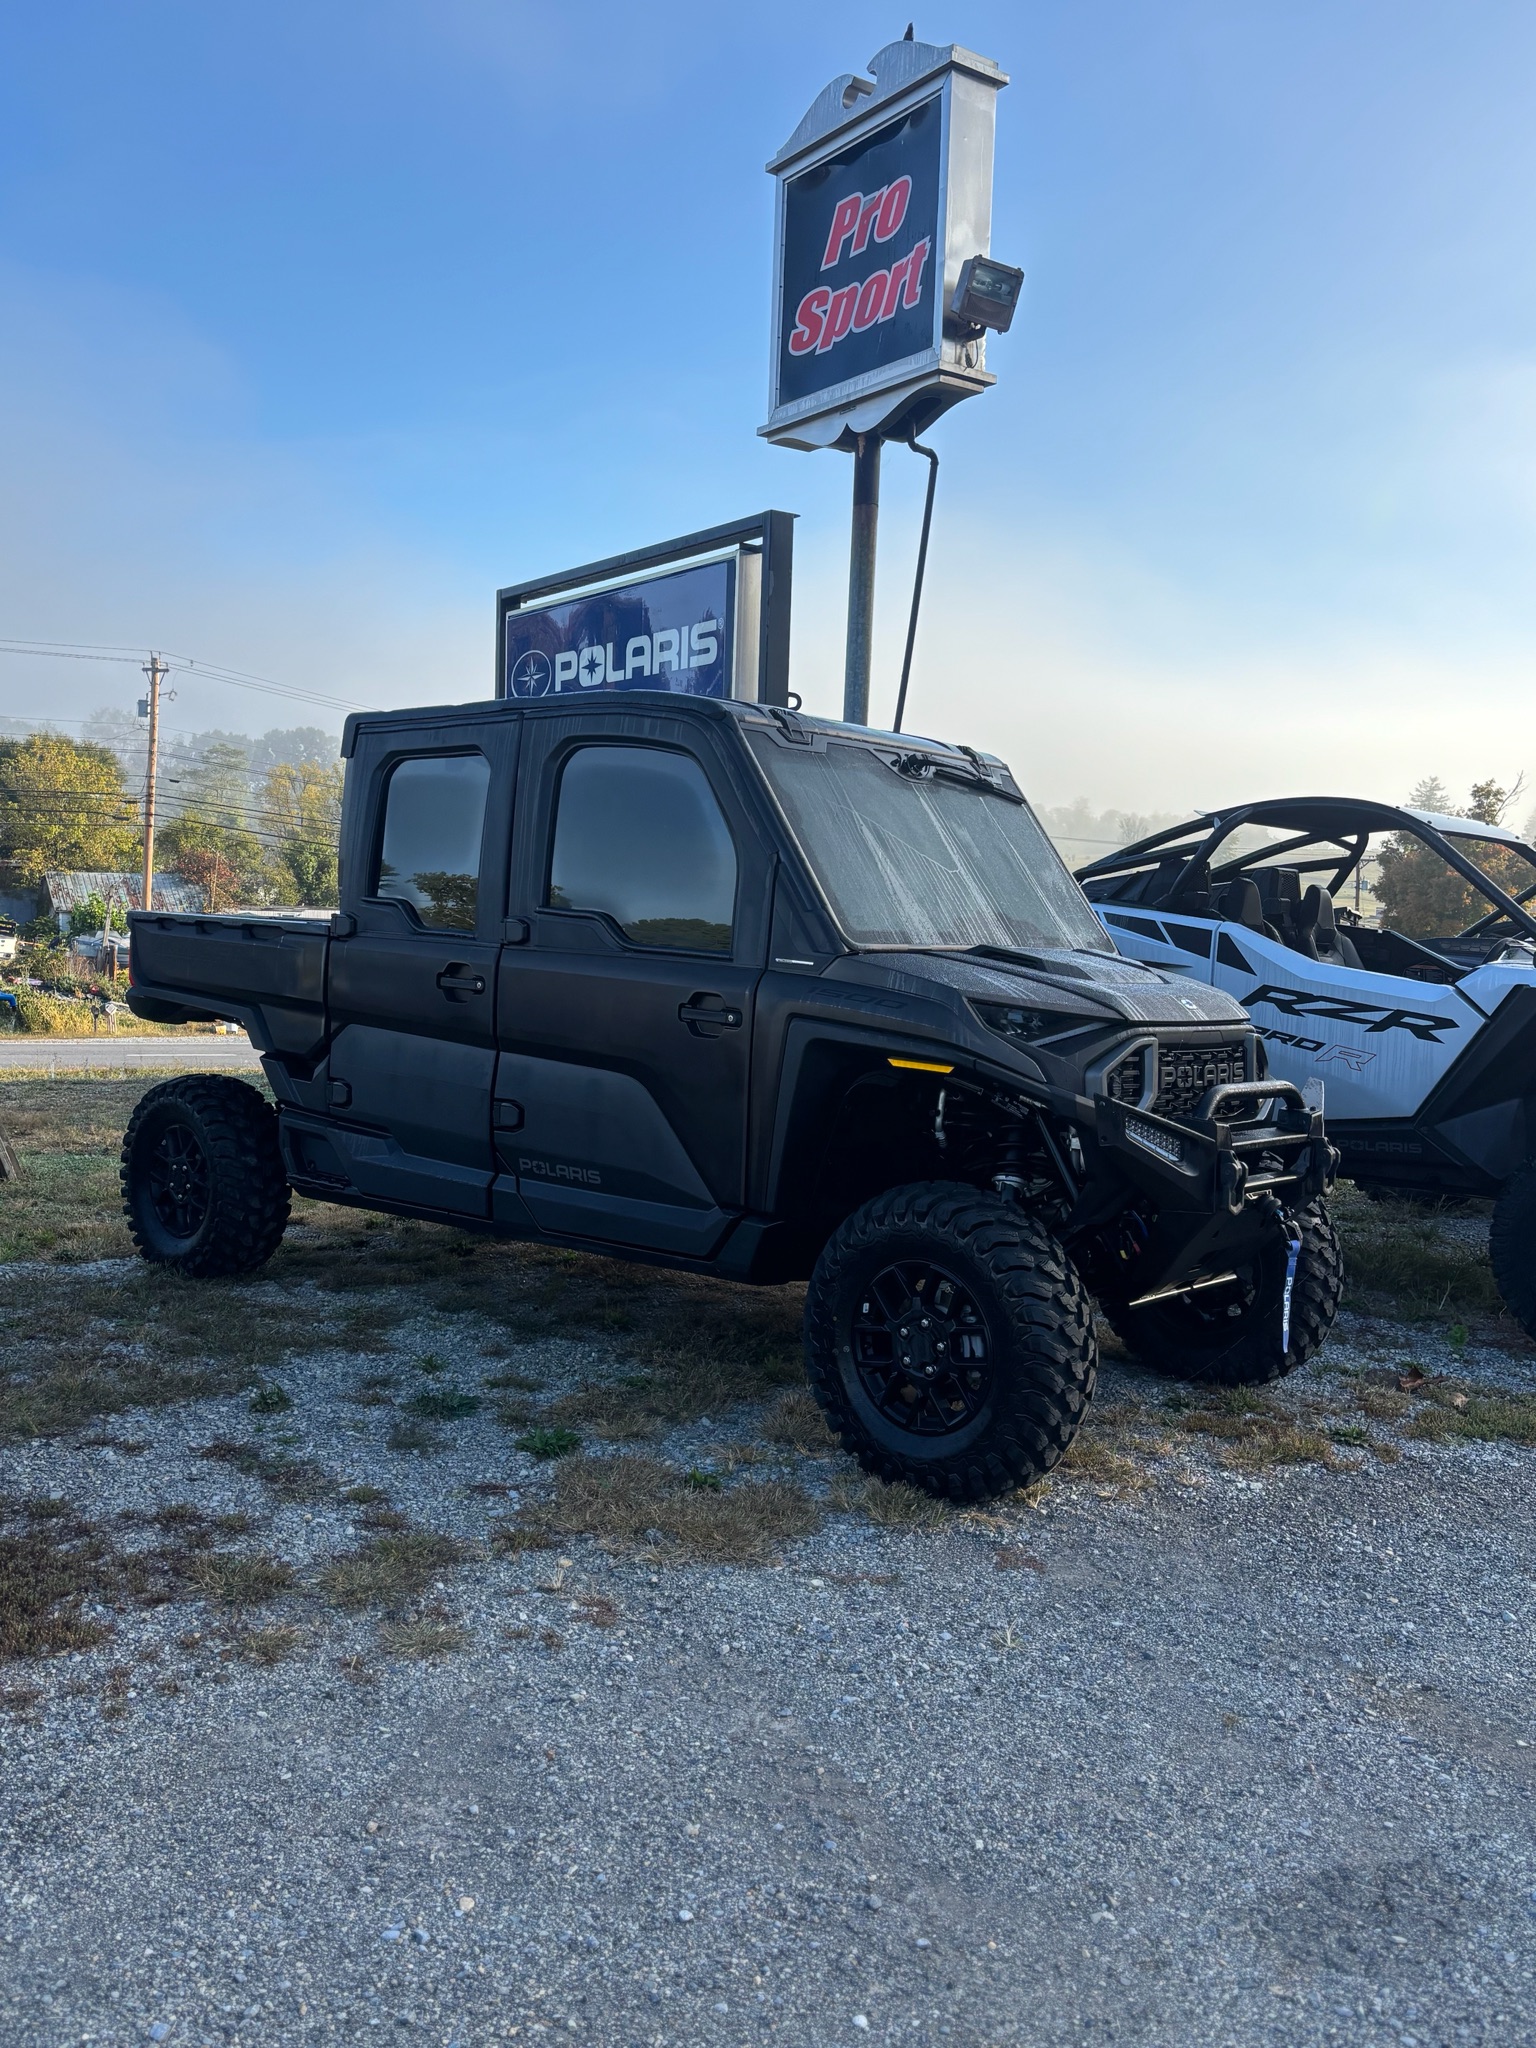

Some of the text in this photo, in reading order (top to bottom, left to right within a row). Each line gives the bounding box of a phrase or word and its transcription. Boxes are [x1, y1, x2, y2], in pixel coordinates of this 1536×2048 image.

[820, 174, 912, 271] Pro
[788, 235, 931, 356] Sport
[555, 618, 718, 692] POLARIS
[806, 986, 908, 1009] 1500
[1239, 983, 1460, 1044] RZR
[1160, 1062, 1245, 1088] POLARIS
[1314, 1044, 1377, 1072] R
[1336, 1138, 1423, 1154] POLARIS
[518, 1157, 602, 1185] POLARIS
[1283, 1276, 1293, 1332] POLARIS
